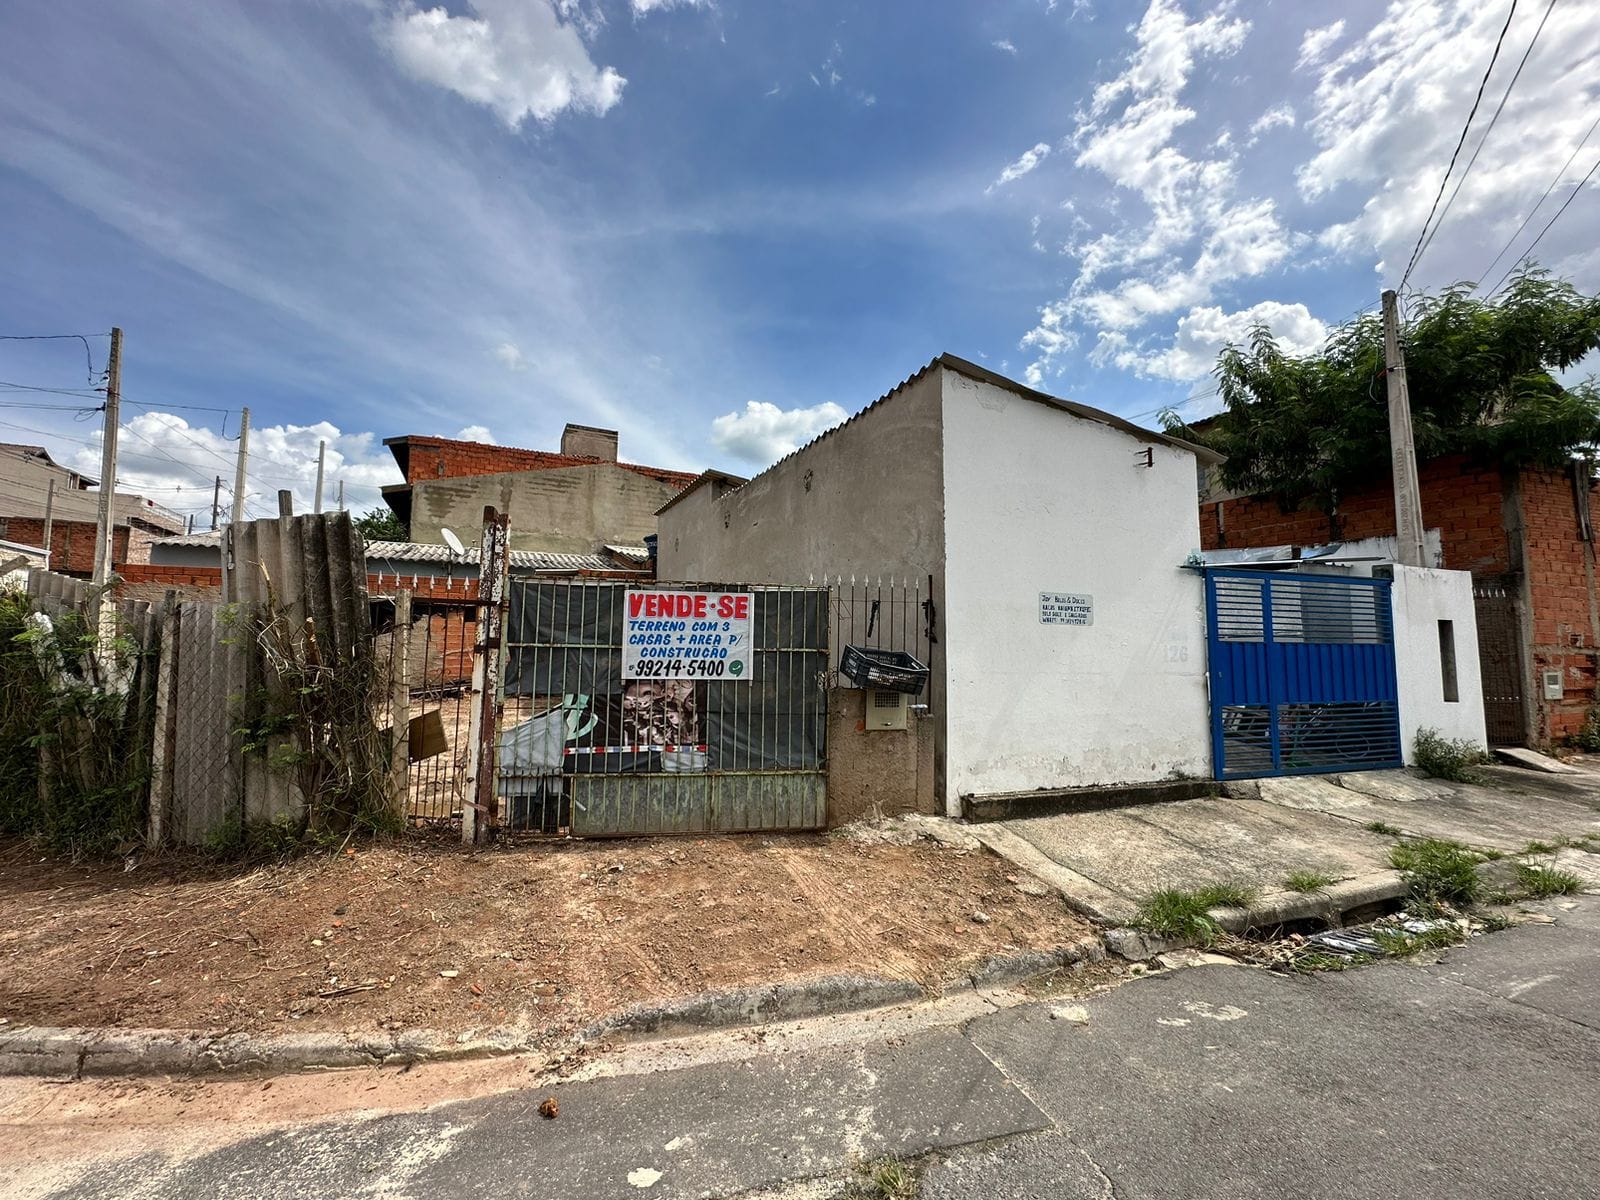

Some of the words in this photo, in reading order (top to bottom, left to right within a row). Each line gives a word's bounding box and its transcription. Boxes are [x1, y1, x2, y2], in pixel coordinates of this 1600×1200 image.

[629, 621, 685, 631] TERRENO
[692, 622, 718, 631] COM
[722, 622, 730, 631] 3
[629, 634, 671, 645] CASAS
[676, 635, 686, 644] +
[689, 634, 721, 645] AREA
[729, 635, 742, 646] P/
